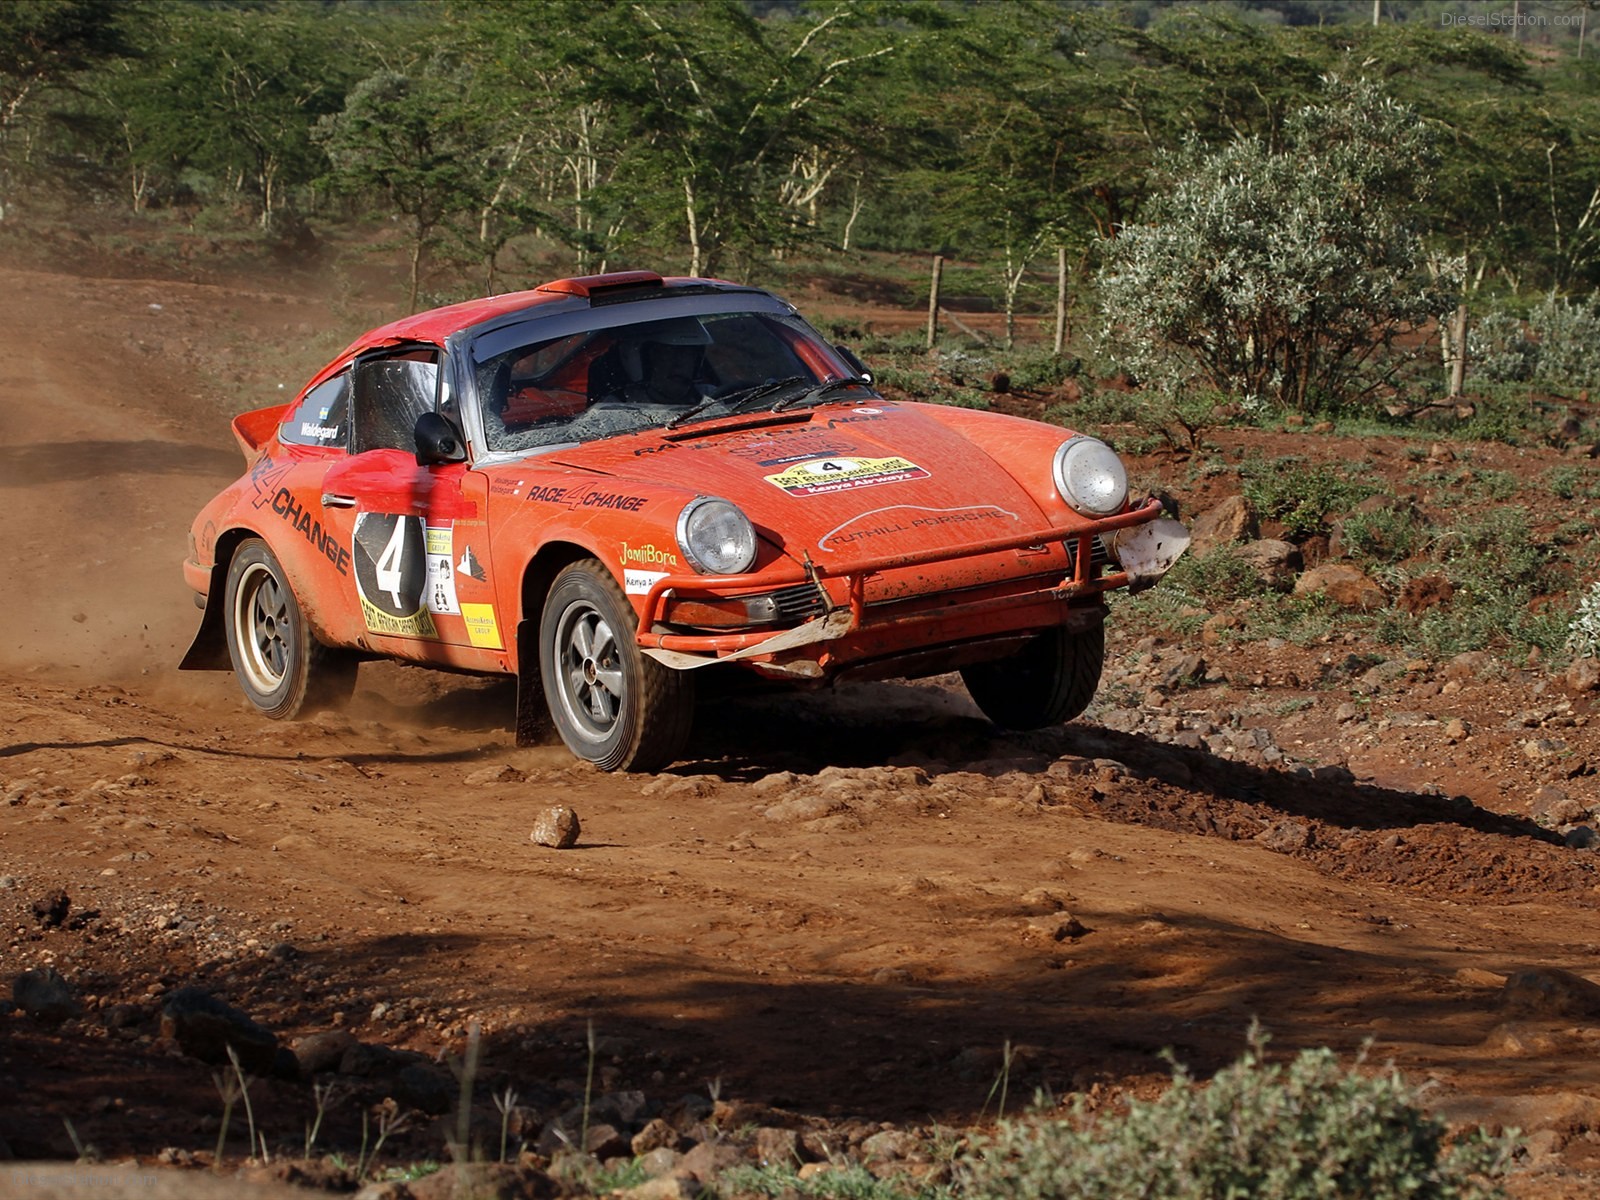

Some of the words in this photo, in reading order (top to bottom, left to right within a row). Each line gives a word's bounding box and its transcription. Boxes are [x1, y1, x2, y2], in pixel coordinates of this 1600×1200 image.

[301, 422, 339, 441] Waldegard
[822, 461, 842, 472] 4
[808, 480, 854, 494] Kenya
[854, 472, 913, 487] Airways
[828, 523, 909, 545] TUTHILL
[911, 510, 1005, 528] PORSCHE
[375, 514, 406, 609] 4
[626, 577, 647, 588] Kenya
